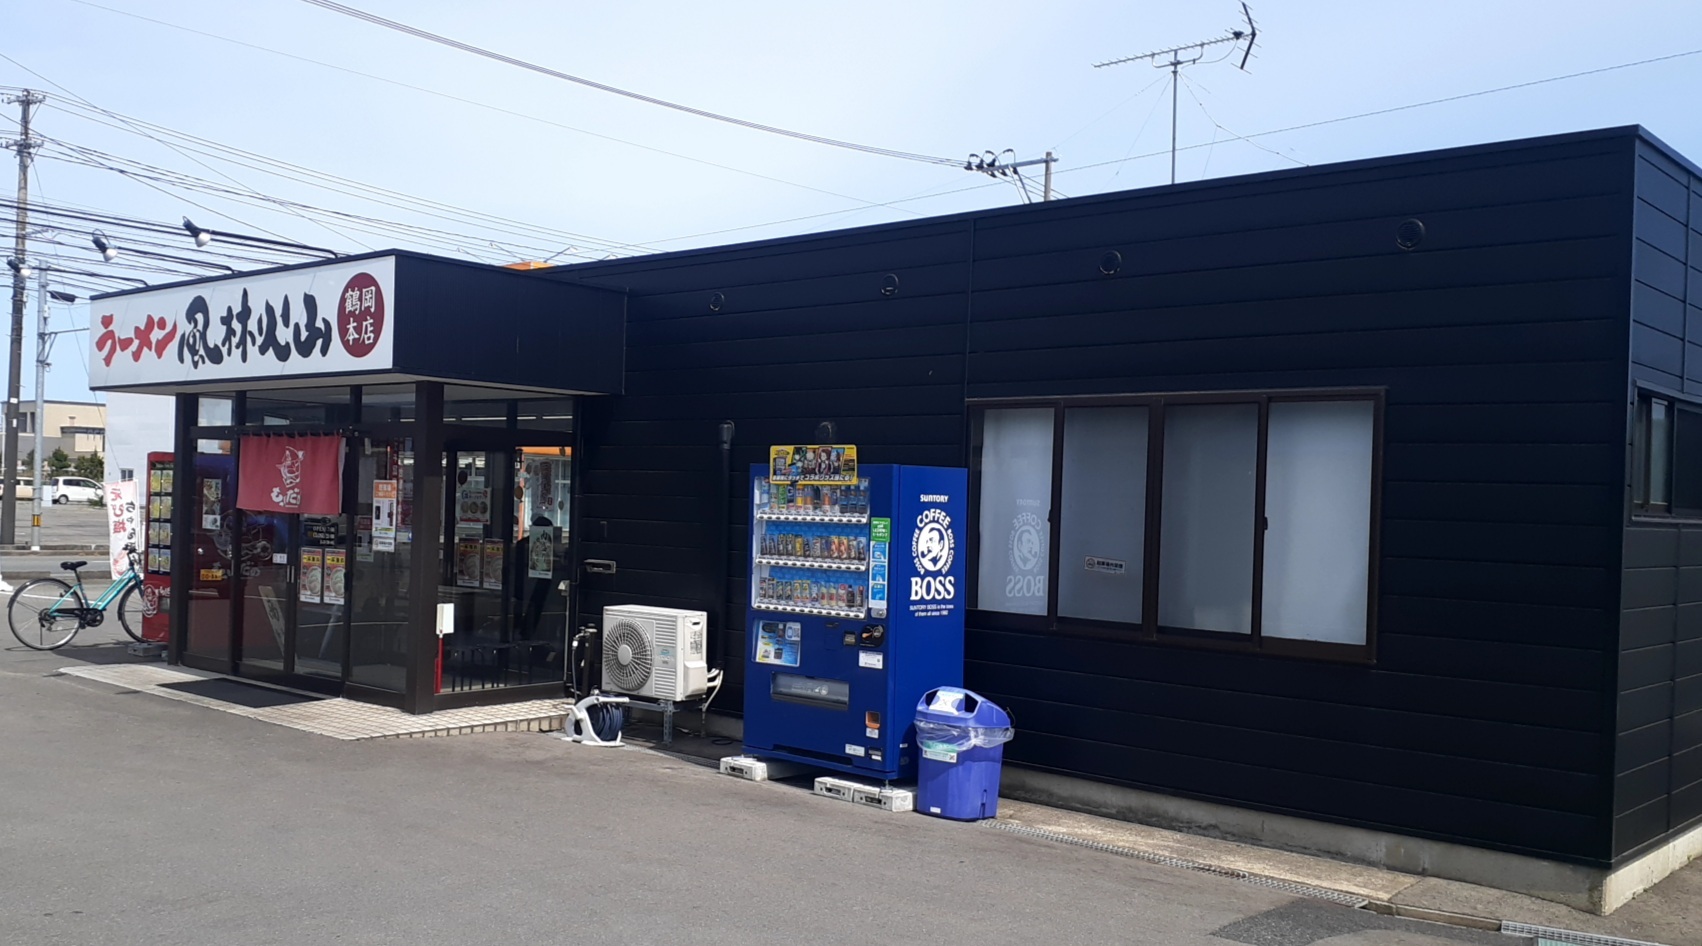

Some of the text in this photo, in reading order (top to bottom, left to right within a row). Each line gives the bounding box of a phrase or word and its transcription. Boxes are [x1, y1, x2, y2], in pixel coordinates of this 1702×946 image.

[344, 285, 376, 315] 鶴岡
[95, 287, 332, 369] ラーメン 風林火山
[344, 317, 375, 346] 本店
[920, 494, 949, 503] SUNTORY
[917, 508, 951, 529] COFFEE
[911, 528, 925, 575] BOSS COFFEE
[941, 528, 955, 575] BOSS COFFEE
[910, 575, 955, 601] BOSS
